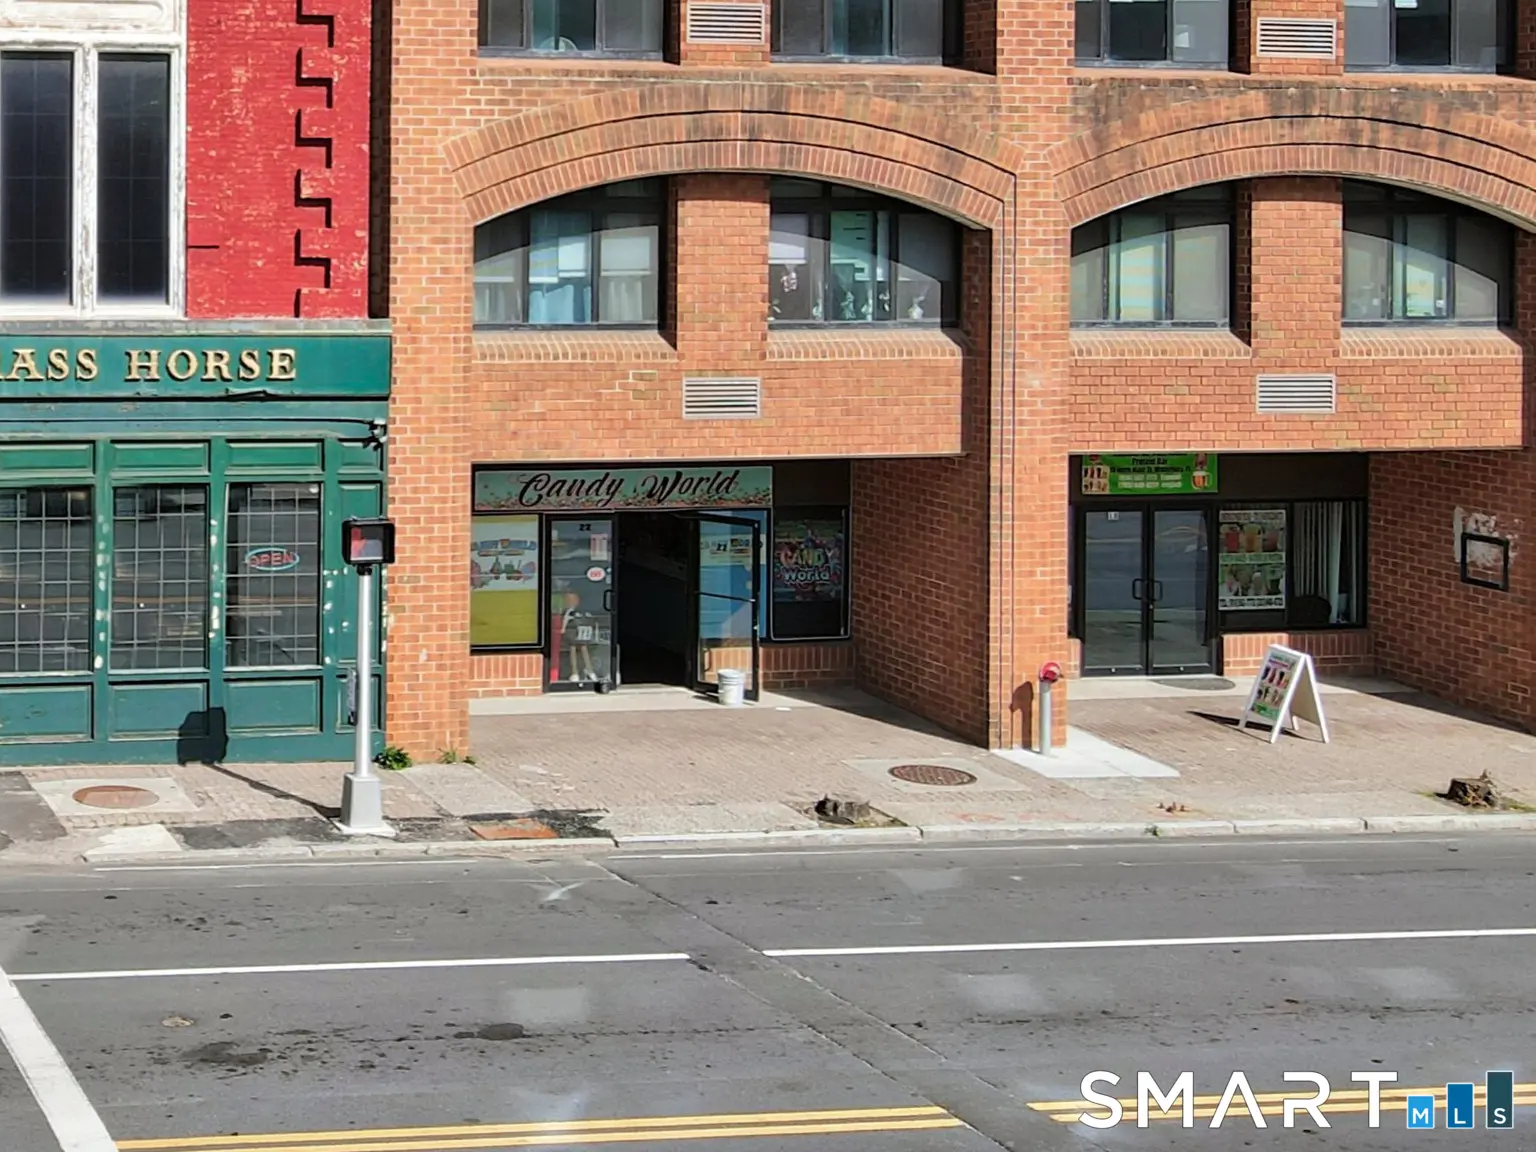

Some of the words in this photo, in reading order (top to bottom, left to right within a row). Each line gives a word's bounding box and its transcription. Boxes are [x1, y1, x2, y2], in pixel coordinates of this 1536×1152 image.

[123, 347, 298, 383] HORSE
[518, 471, 626, 508] Candy
[640, 469, 741, 505] World
[249, 551, 295, 566] OPEN
[780, 546, 838, 568] CANDY
[782, 567, 831, 583] World
